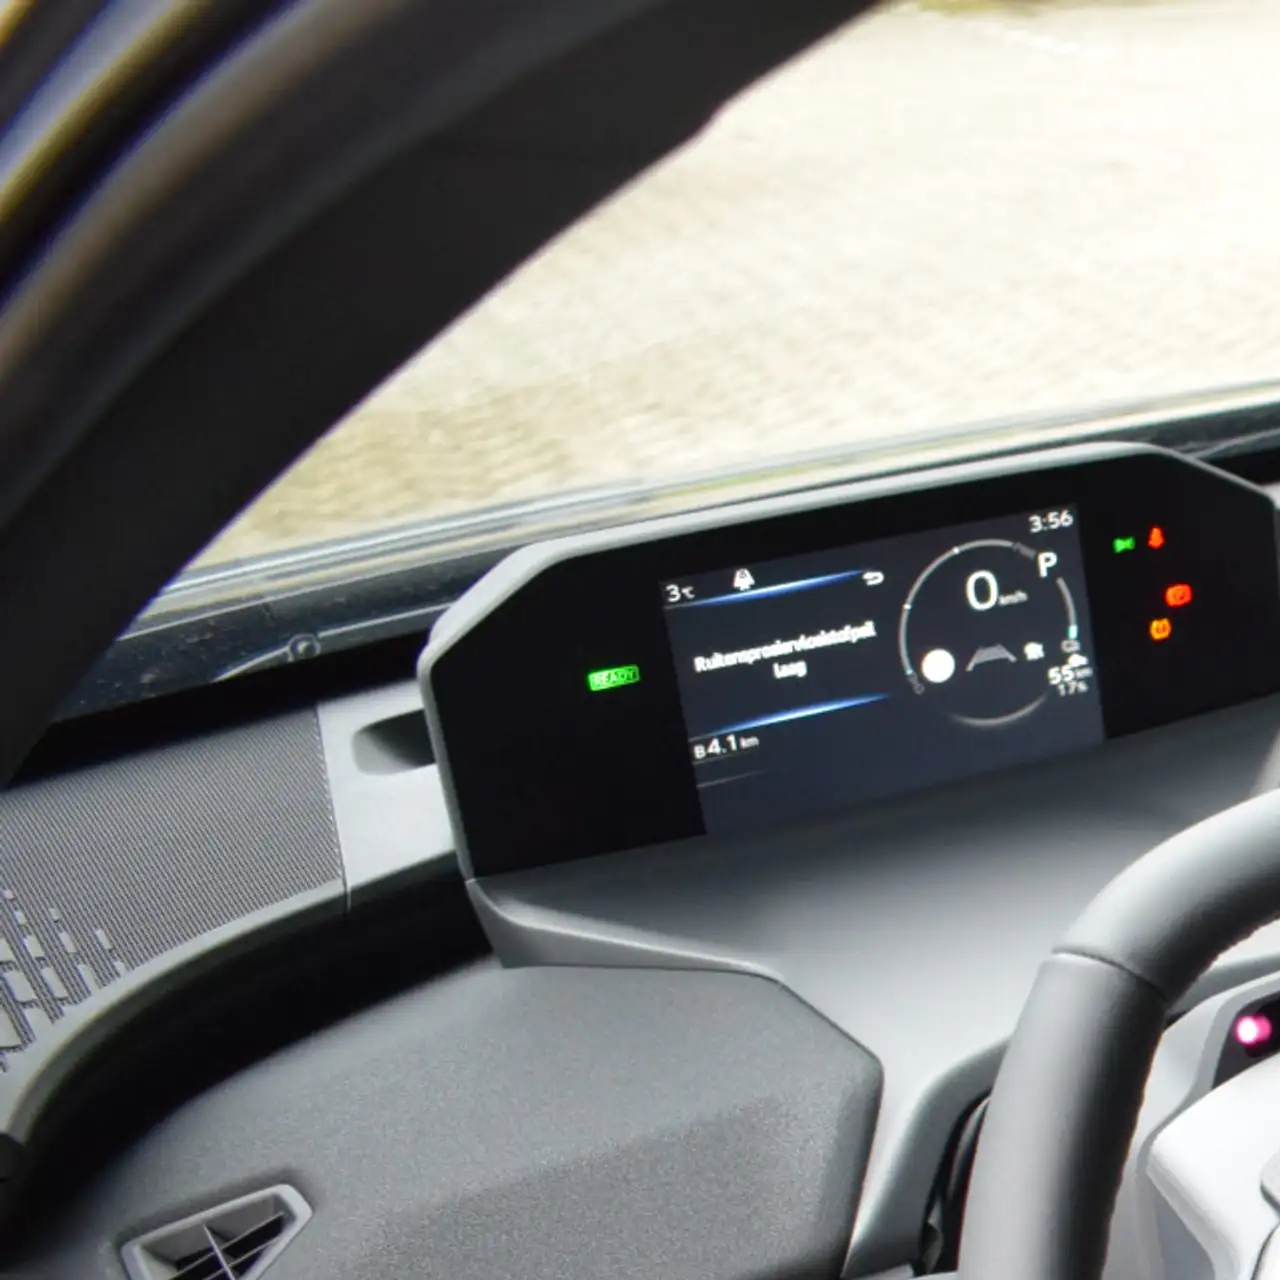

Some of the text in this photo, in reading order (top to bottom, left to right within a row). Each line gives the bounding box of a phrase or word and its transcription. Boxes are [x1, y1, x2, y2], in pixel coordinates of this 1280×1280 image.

[1028, 510, 1074, 533] 3:56
[1037, 552, 1058, 578] P
[965, 570, 999, 611] 0
[1048, 666, 1075, 684] 55
[705, 734, 738, 756] 4.1
